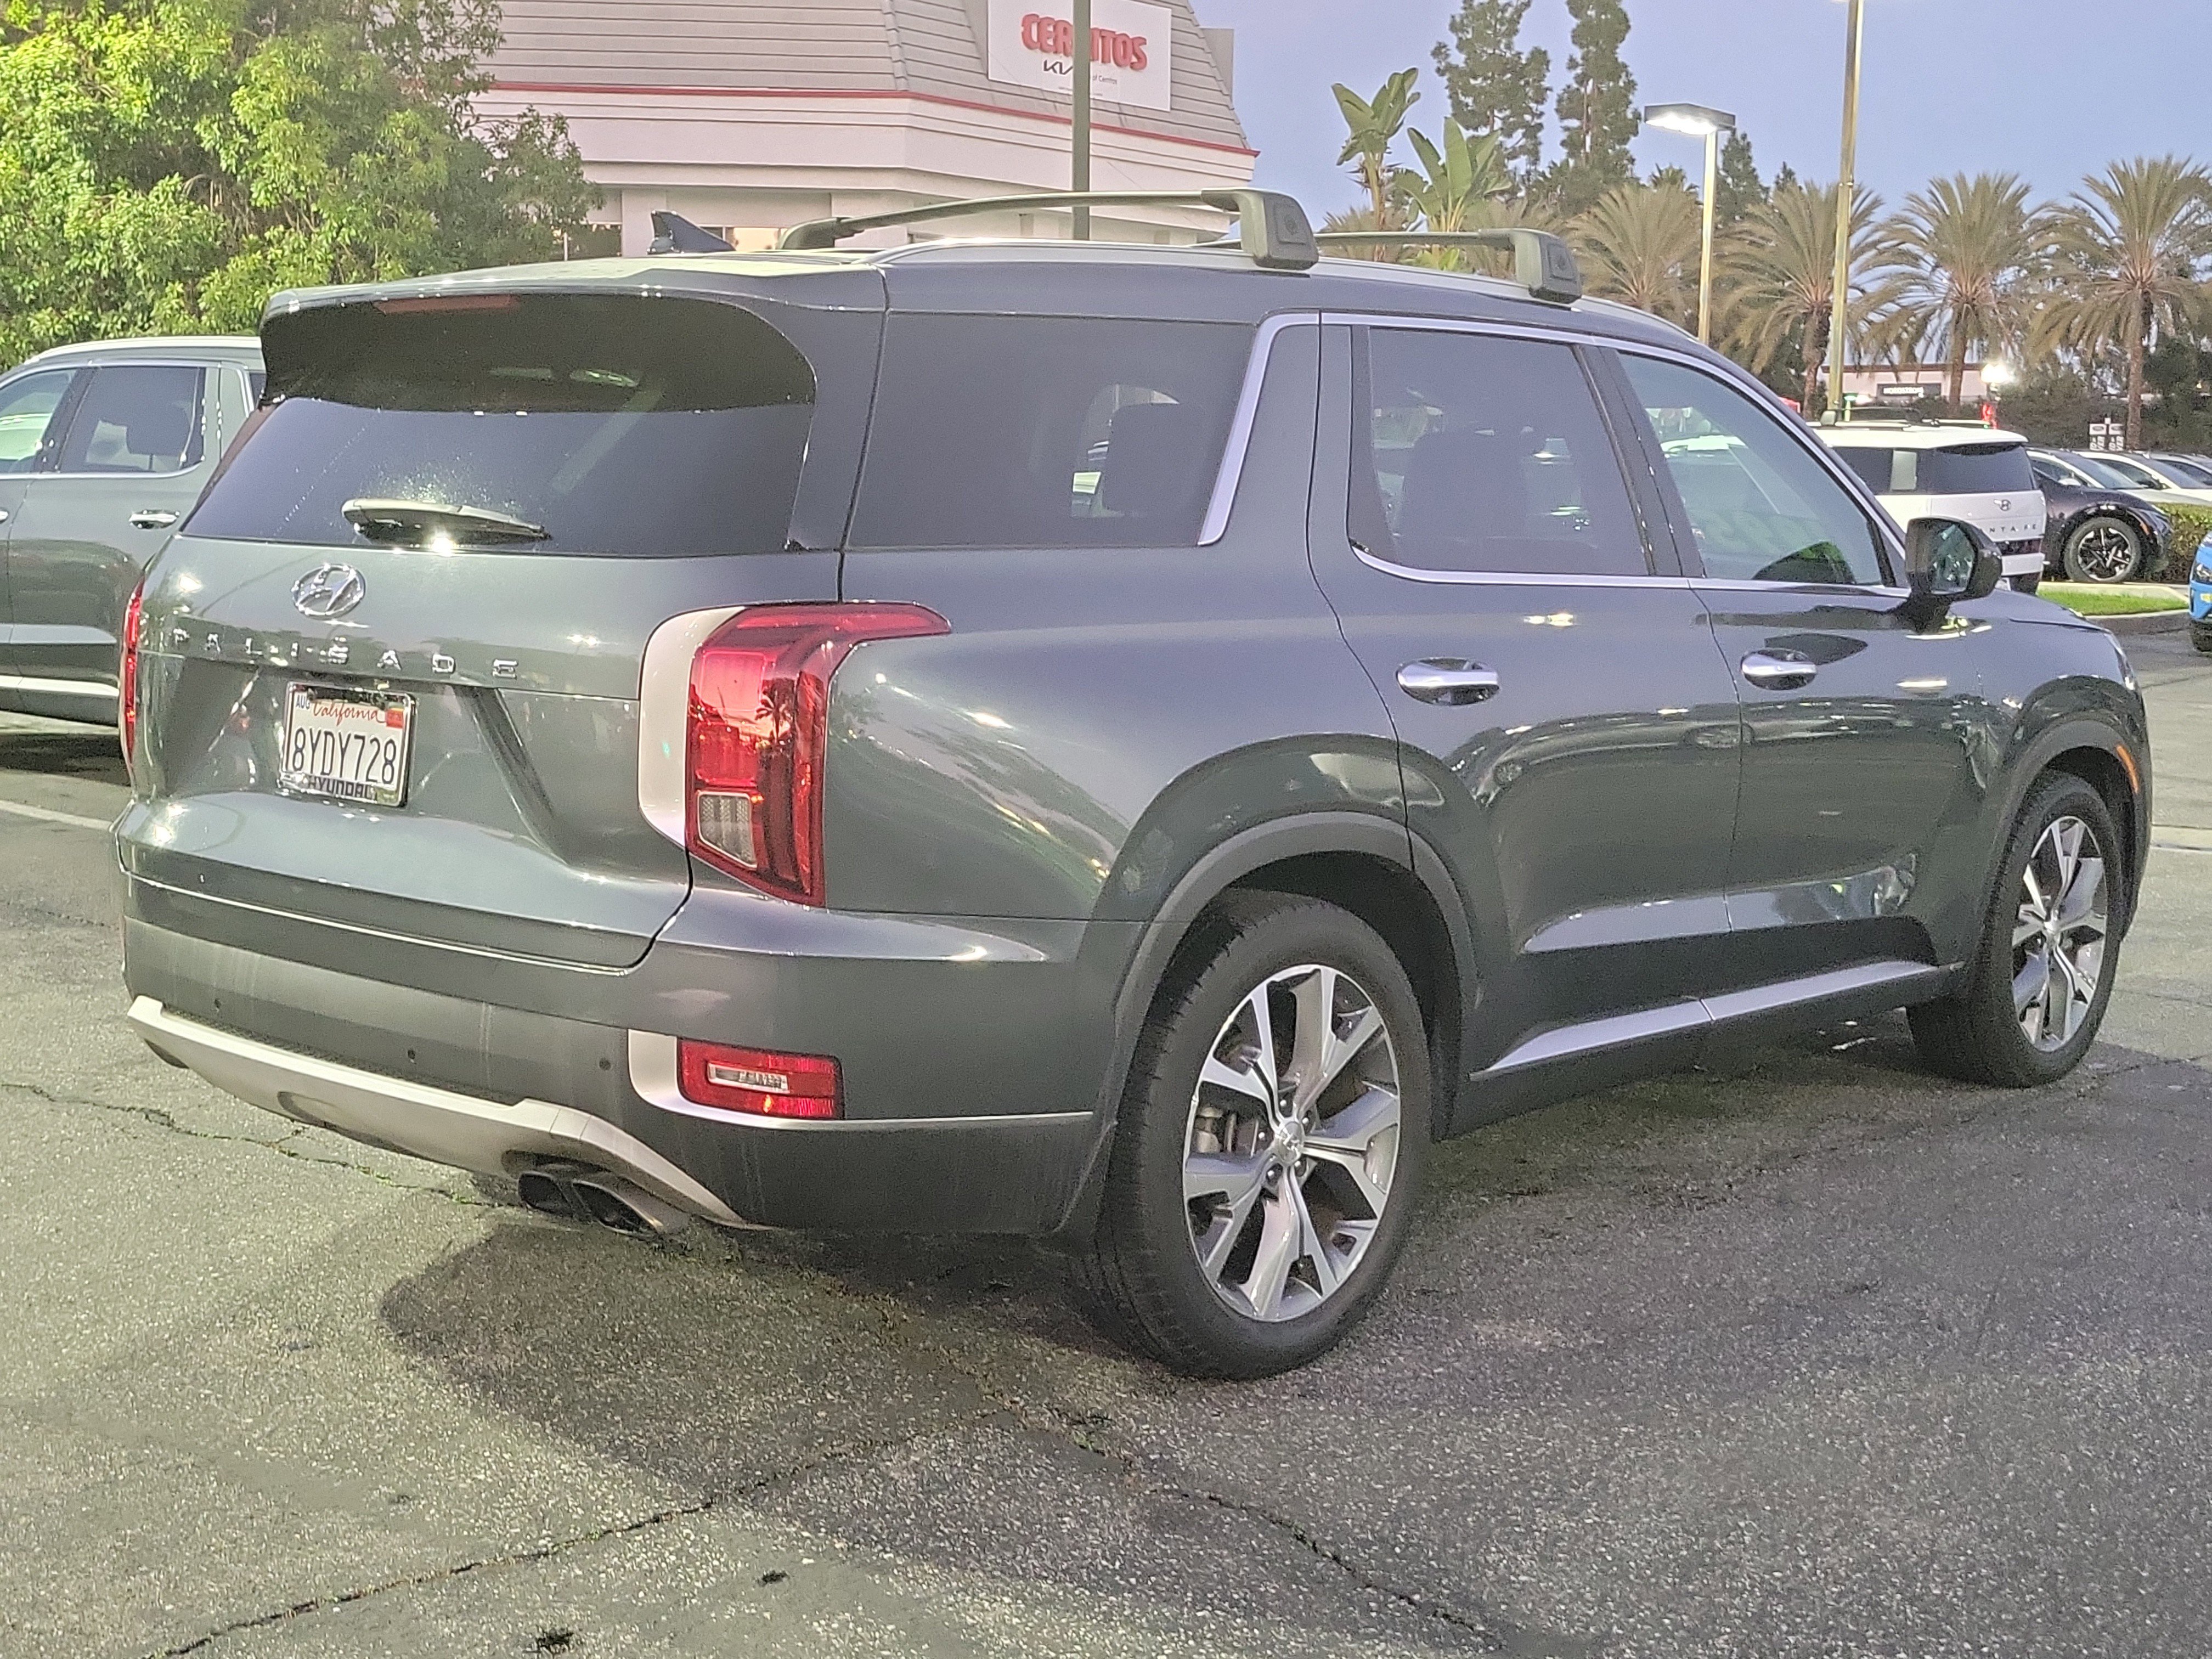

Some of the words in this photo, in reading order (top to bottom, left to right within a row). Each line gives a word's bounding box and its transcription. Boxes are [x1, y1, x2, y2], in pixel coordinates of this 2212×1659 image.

[1022, 13, 1147, 71] CERITOS
[296, 695, 310, 709] AUG
[313, 701, 386, 726] California
[292, 727, 397, 785] 8YDY728
